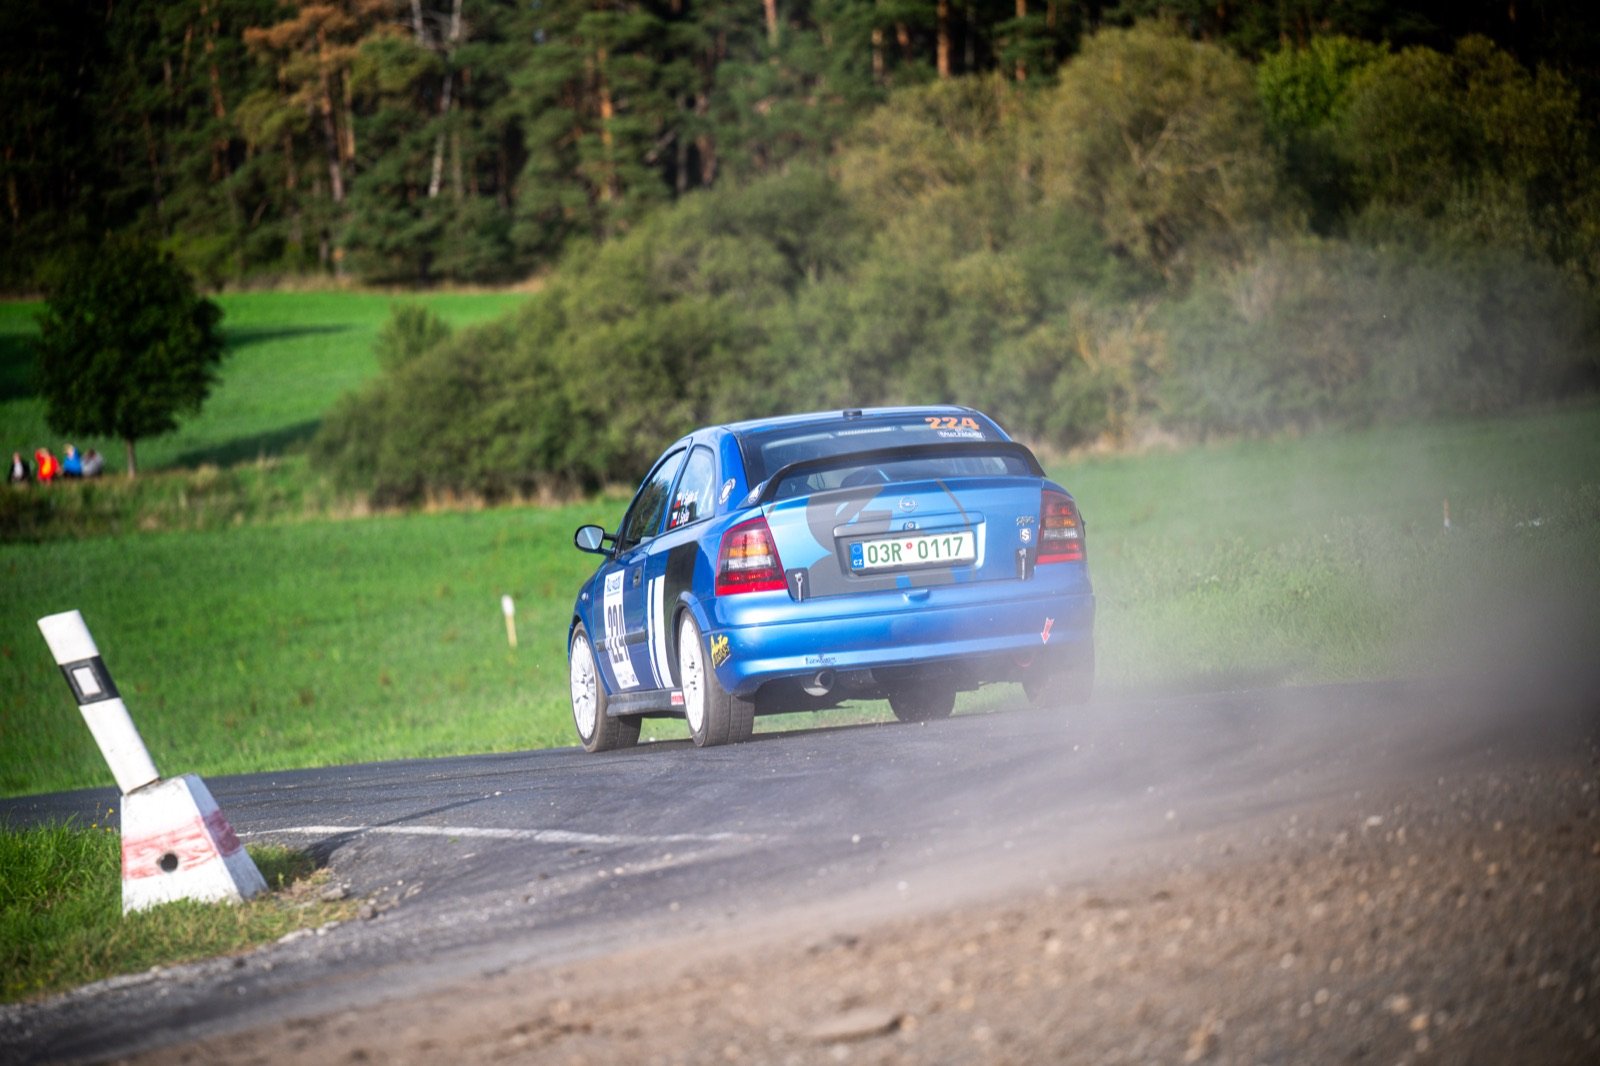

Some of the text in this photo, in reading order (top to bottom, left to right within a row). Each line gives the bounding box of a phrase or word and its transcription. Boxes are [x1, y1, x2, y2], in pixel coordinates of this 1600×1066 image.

[925, 416, 979, 430] 224
[867, 536, 963, 564] 03R 0117
[853, 558, 863, 566] CZ
[607, 604, 629, 664] 224
